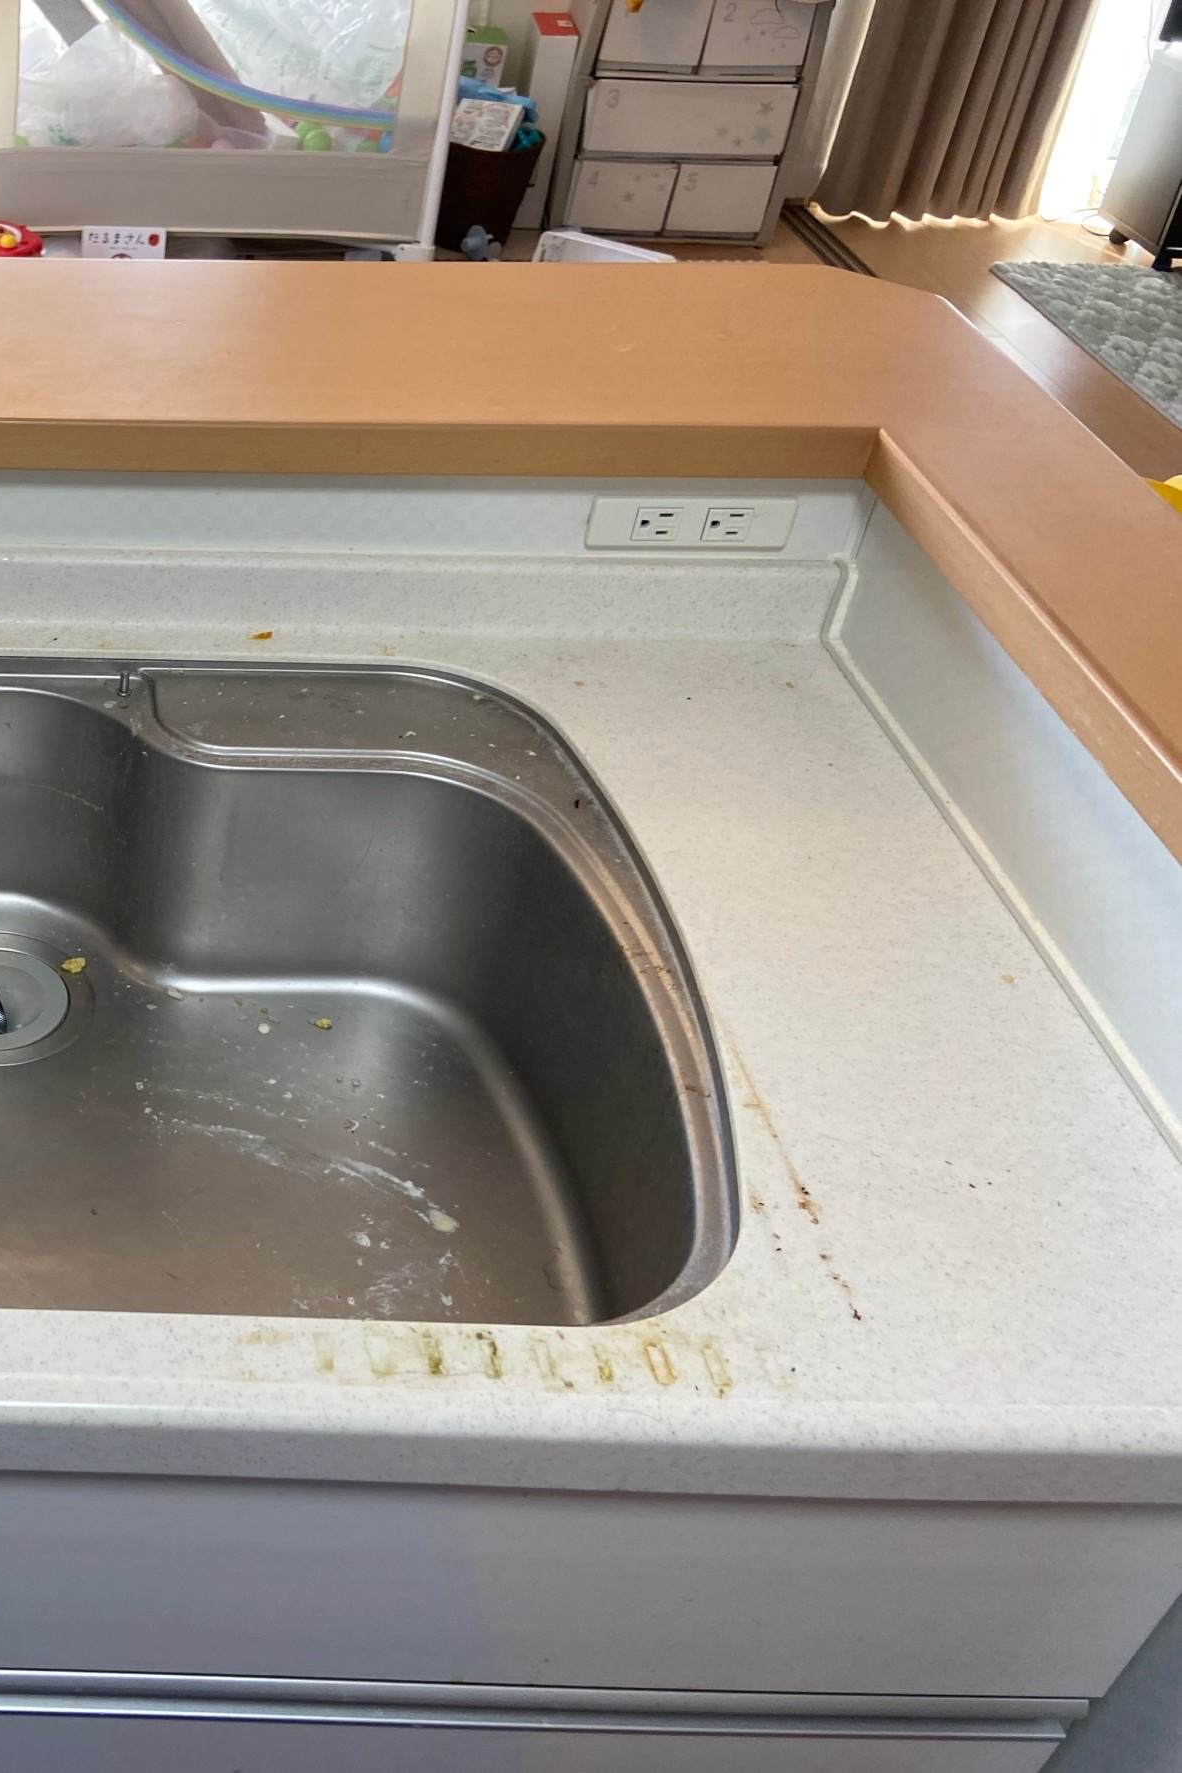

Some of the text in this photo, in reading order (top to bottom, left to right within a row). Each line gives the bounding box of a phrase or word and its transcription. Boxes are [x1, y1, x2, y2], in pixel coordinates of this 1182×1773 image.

[723, 3, 737, 22] 2
[606, 89, 620, 109] 3
[684, 172, 698, 191] 5
[88, 232, 145, 245] だるまさん
